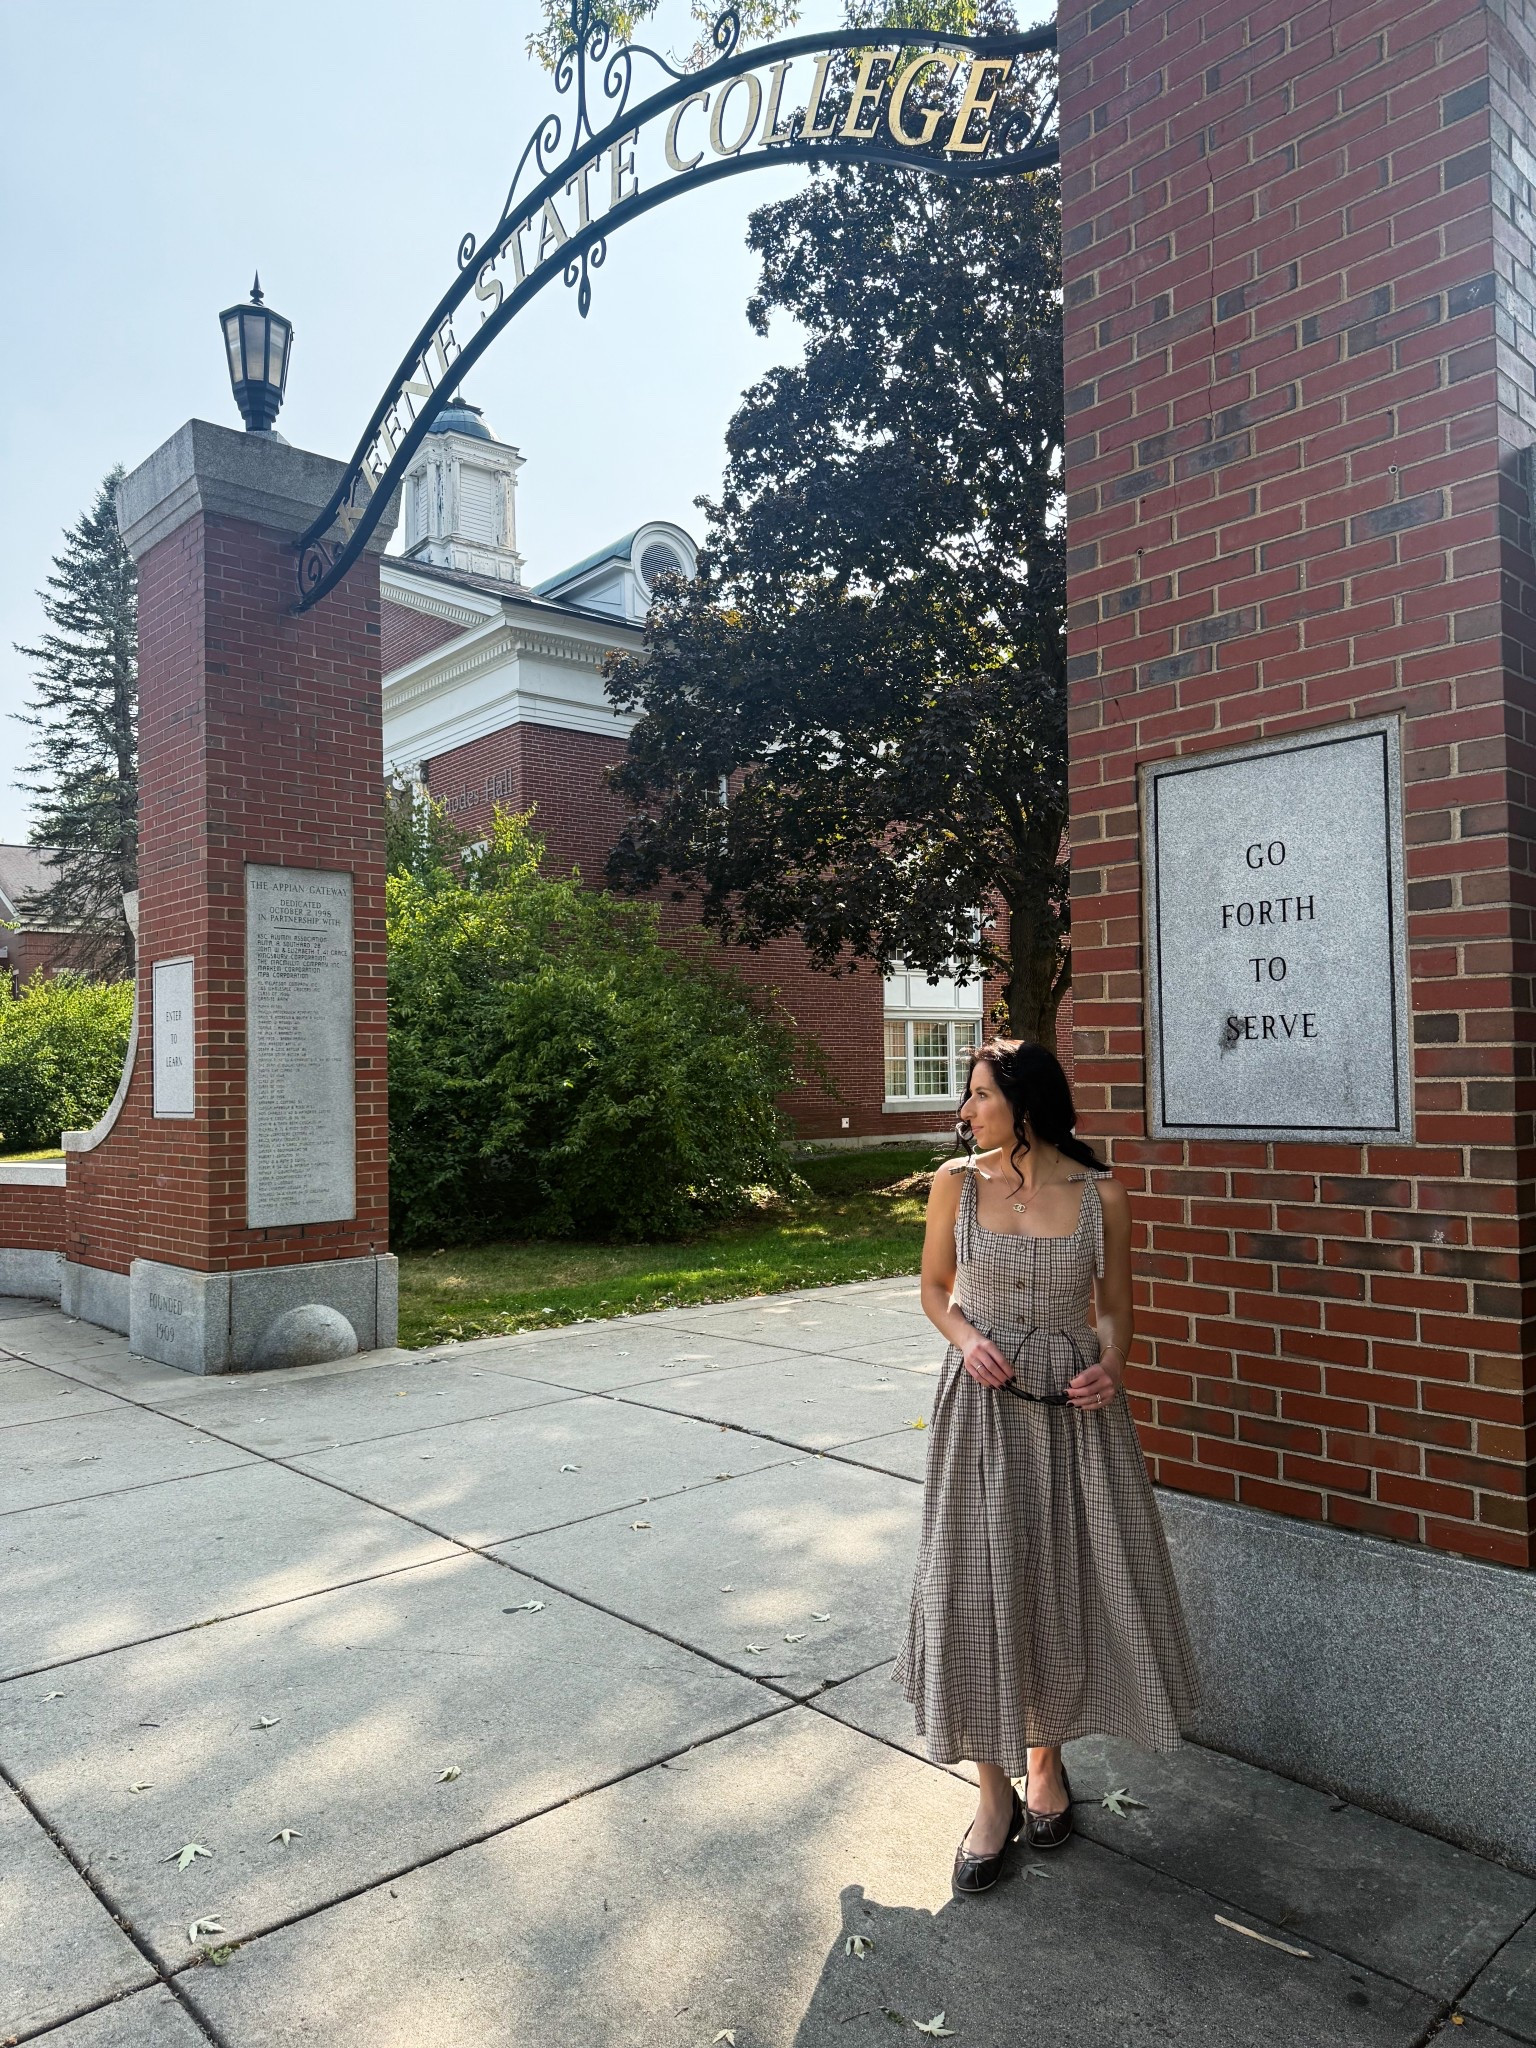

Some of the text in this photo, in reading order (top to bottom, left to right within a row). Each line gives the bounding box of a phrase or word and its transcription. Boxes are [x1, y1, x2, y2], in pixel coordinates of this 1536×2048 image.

[335, 51, 1012, 539] KEENE STATE COLLEGE
[485, 767, 513, 802] Hall
[1245, 841, 1286, 869] GO
[250, 881, 348, 897] THE APPIAN GATEWAY
[269, 907, 303, 916] OCTOBER
[315, 910, 332, 918] 1998
[280, 899, 321, 909] DEDICATED
[1221, 895, 1316, 929] FORTH
[270, 915, 319, 925] PARTNERSHIP
[322, 918, 341, 927] WITH
[293, 935, 328, 943] ASSOCIATION
[1249, 956, 1287, 982] TO
[166, 1010, 182, 1022] ENTER
[1227, 1012, 1318, 1041] SERVE
[170, 1033, 178, 1044] TO
[166, 1056, 183, 1067] LEARN
[149, 1292, 183, 1315] FOUNDED
[156, 1323, 175, 1342] 1909
